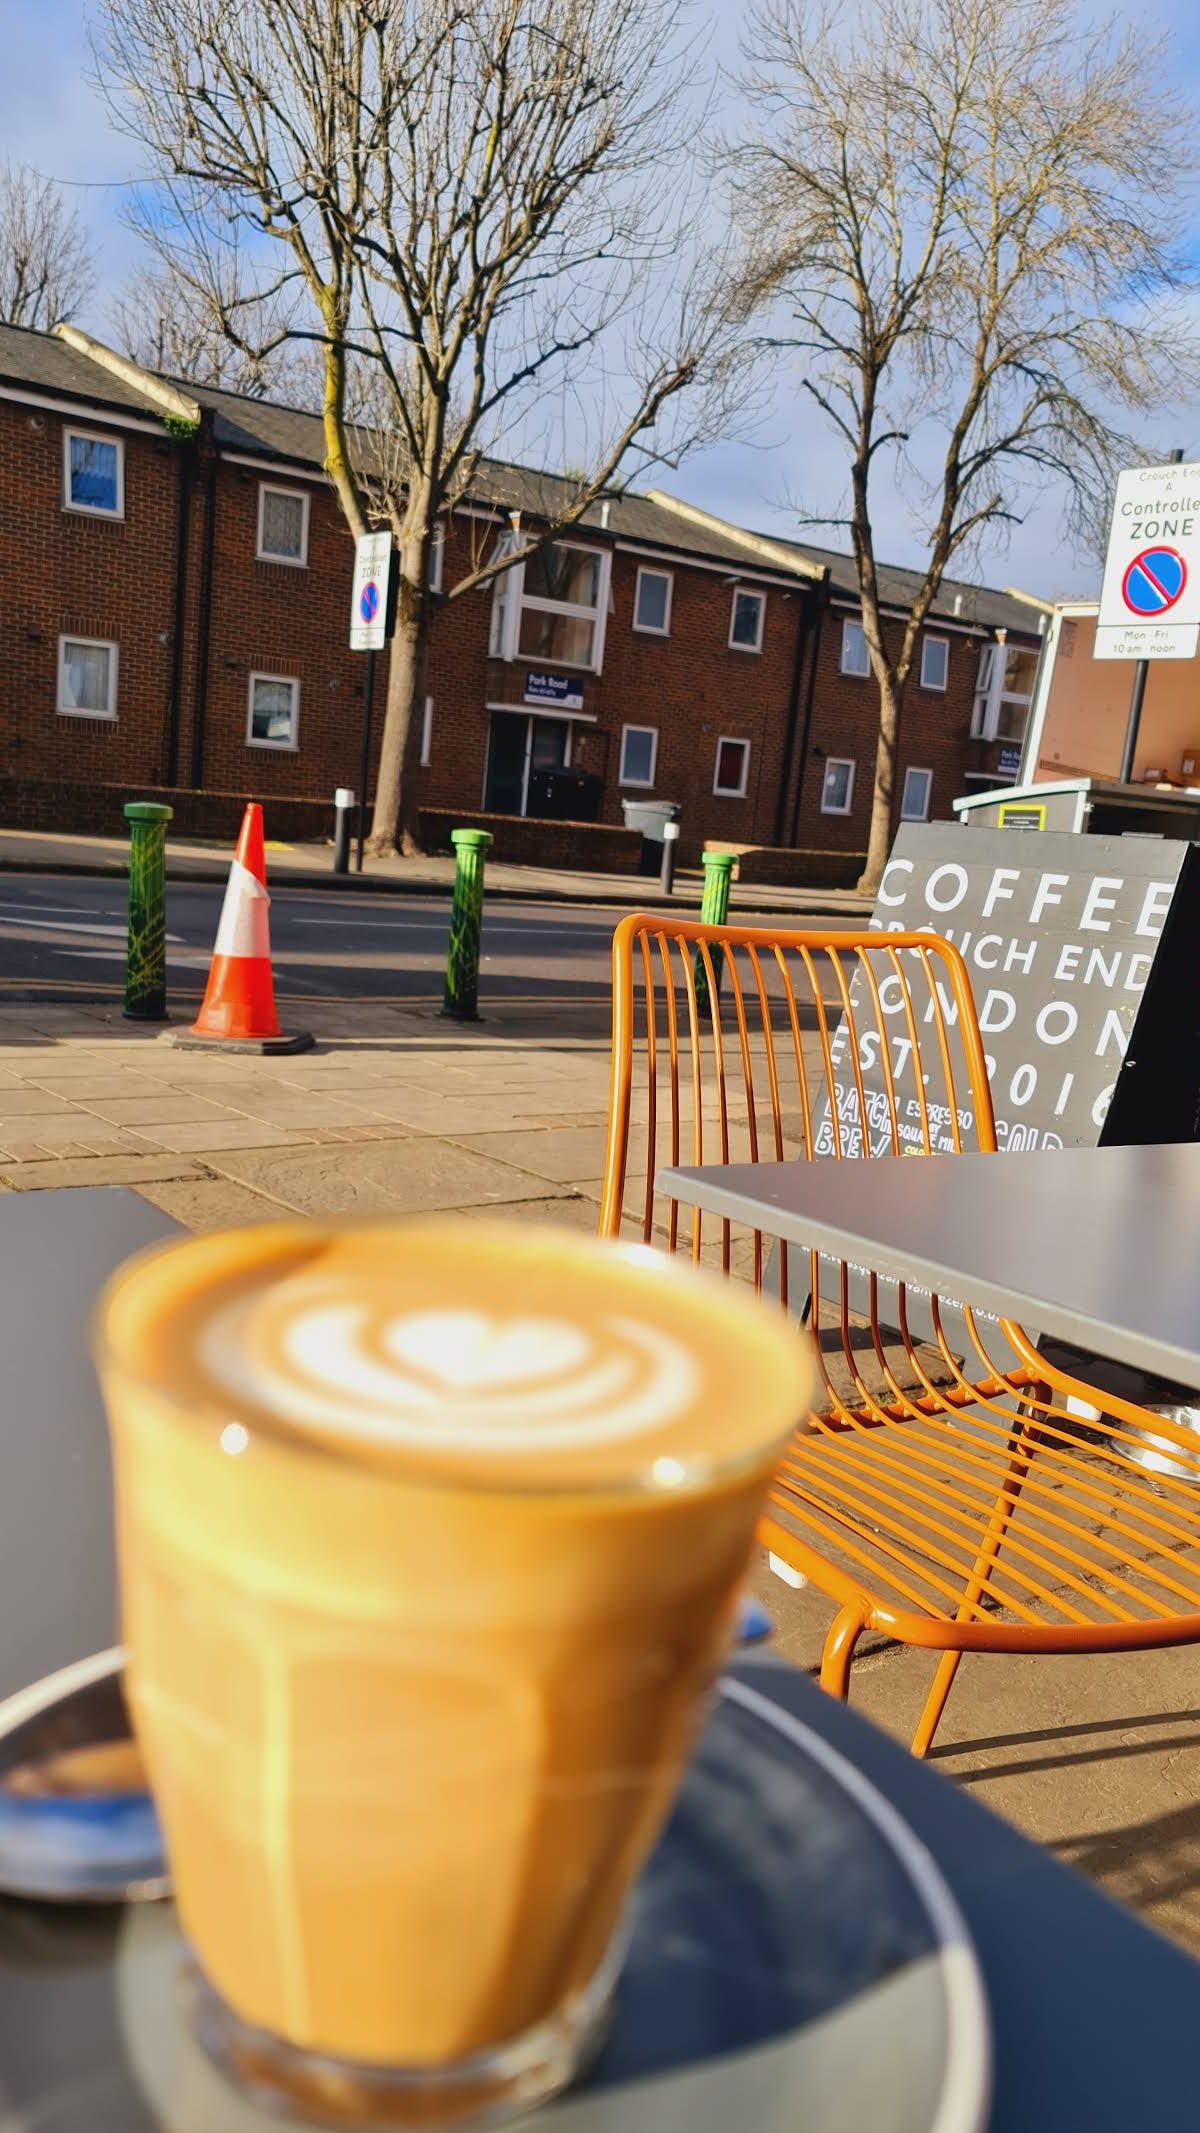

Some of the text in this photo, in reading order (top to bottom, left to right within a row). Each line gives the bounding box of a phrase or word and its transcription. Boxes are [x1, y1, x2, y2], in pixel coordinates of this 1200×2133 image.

[1130, 518, 1194, 539] ZONE
[877, 860, 1175, 938] COFFEE
[1054, 944, 1152, 992] END
[897, 1123, 938, 1148] SQUAE
[938, 1135, 964, 1154] MIL
